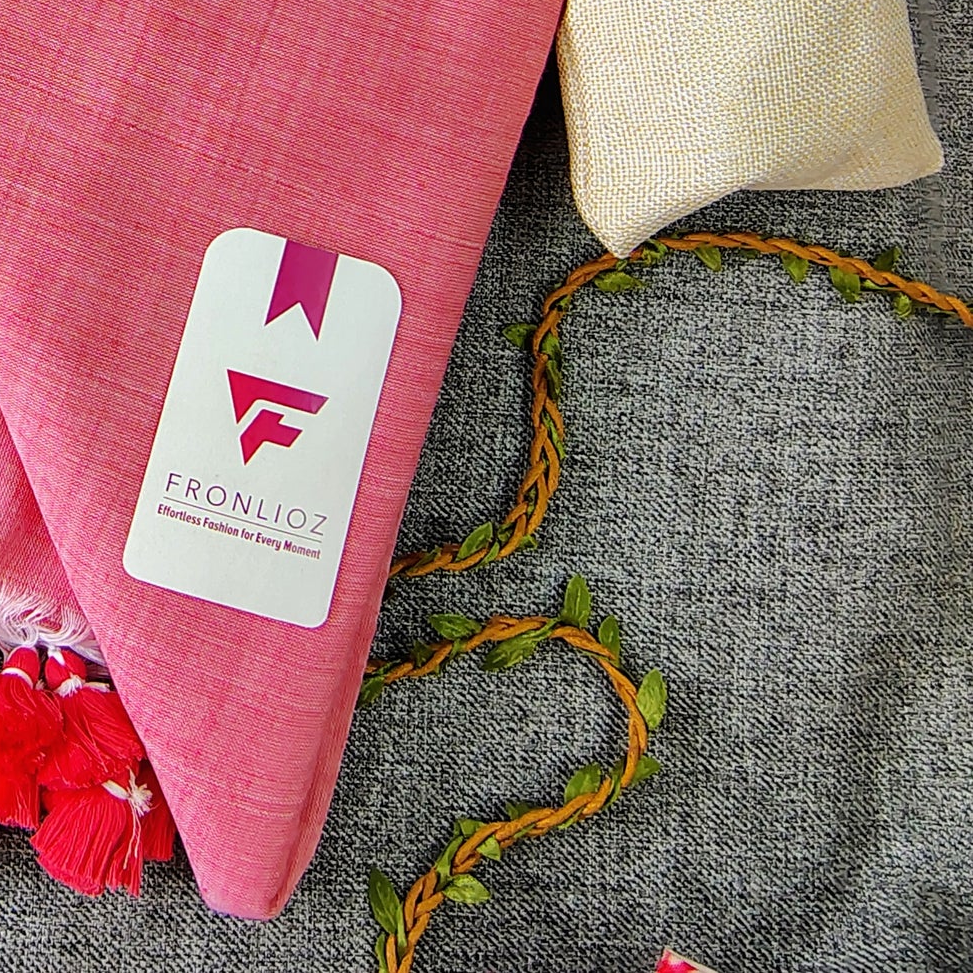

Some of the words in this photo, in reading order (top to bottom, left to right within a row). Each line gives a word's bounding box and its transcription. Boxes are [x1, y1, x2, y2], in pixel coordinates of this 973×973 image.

[157, 503, 201, 528] Effortless
[202, 516, 239, 538] Fashion
[240, 526, 255, 542] for
[255, 530, 282, 552] Every
[283, 538, 321, 560] Moment
[165, 473, 328, 536] FRONLIOZ
